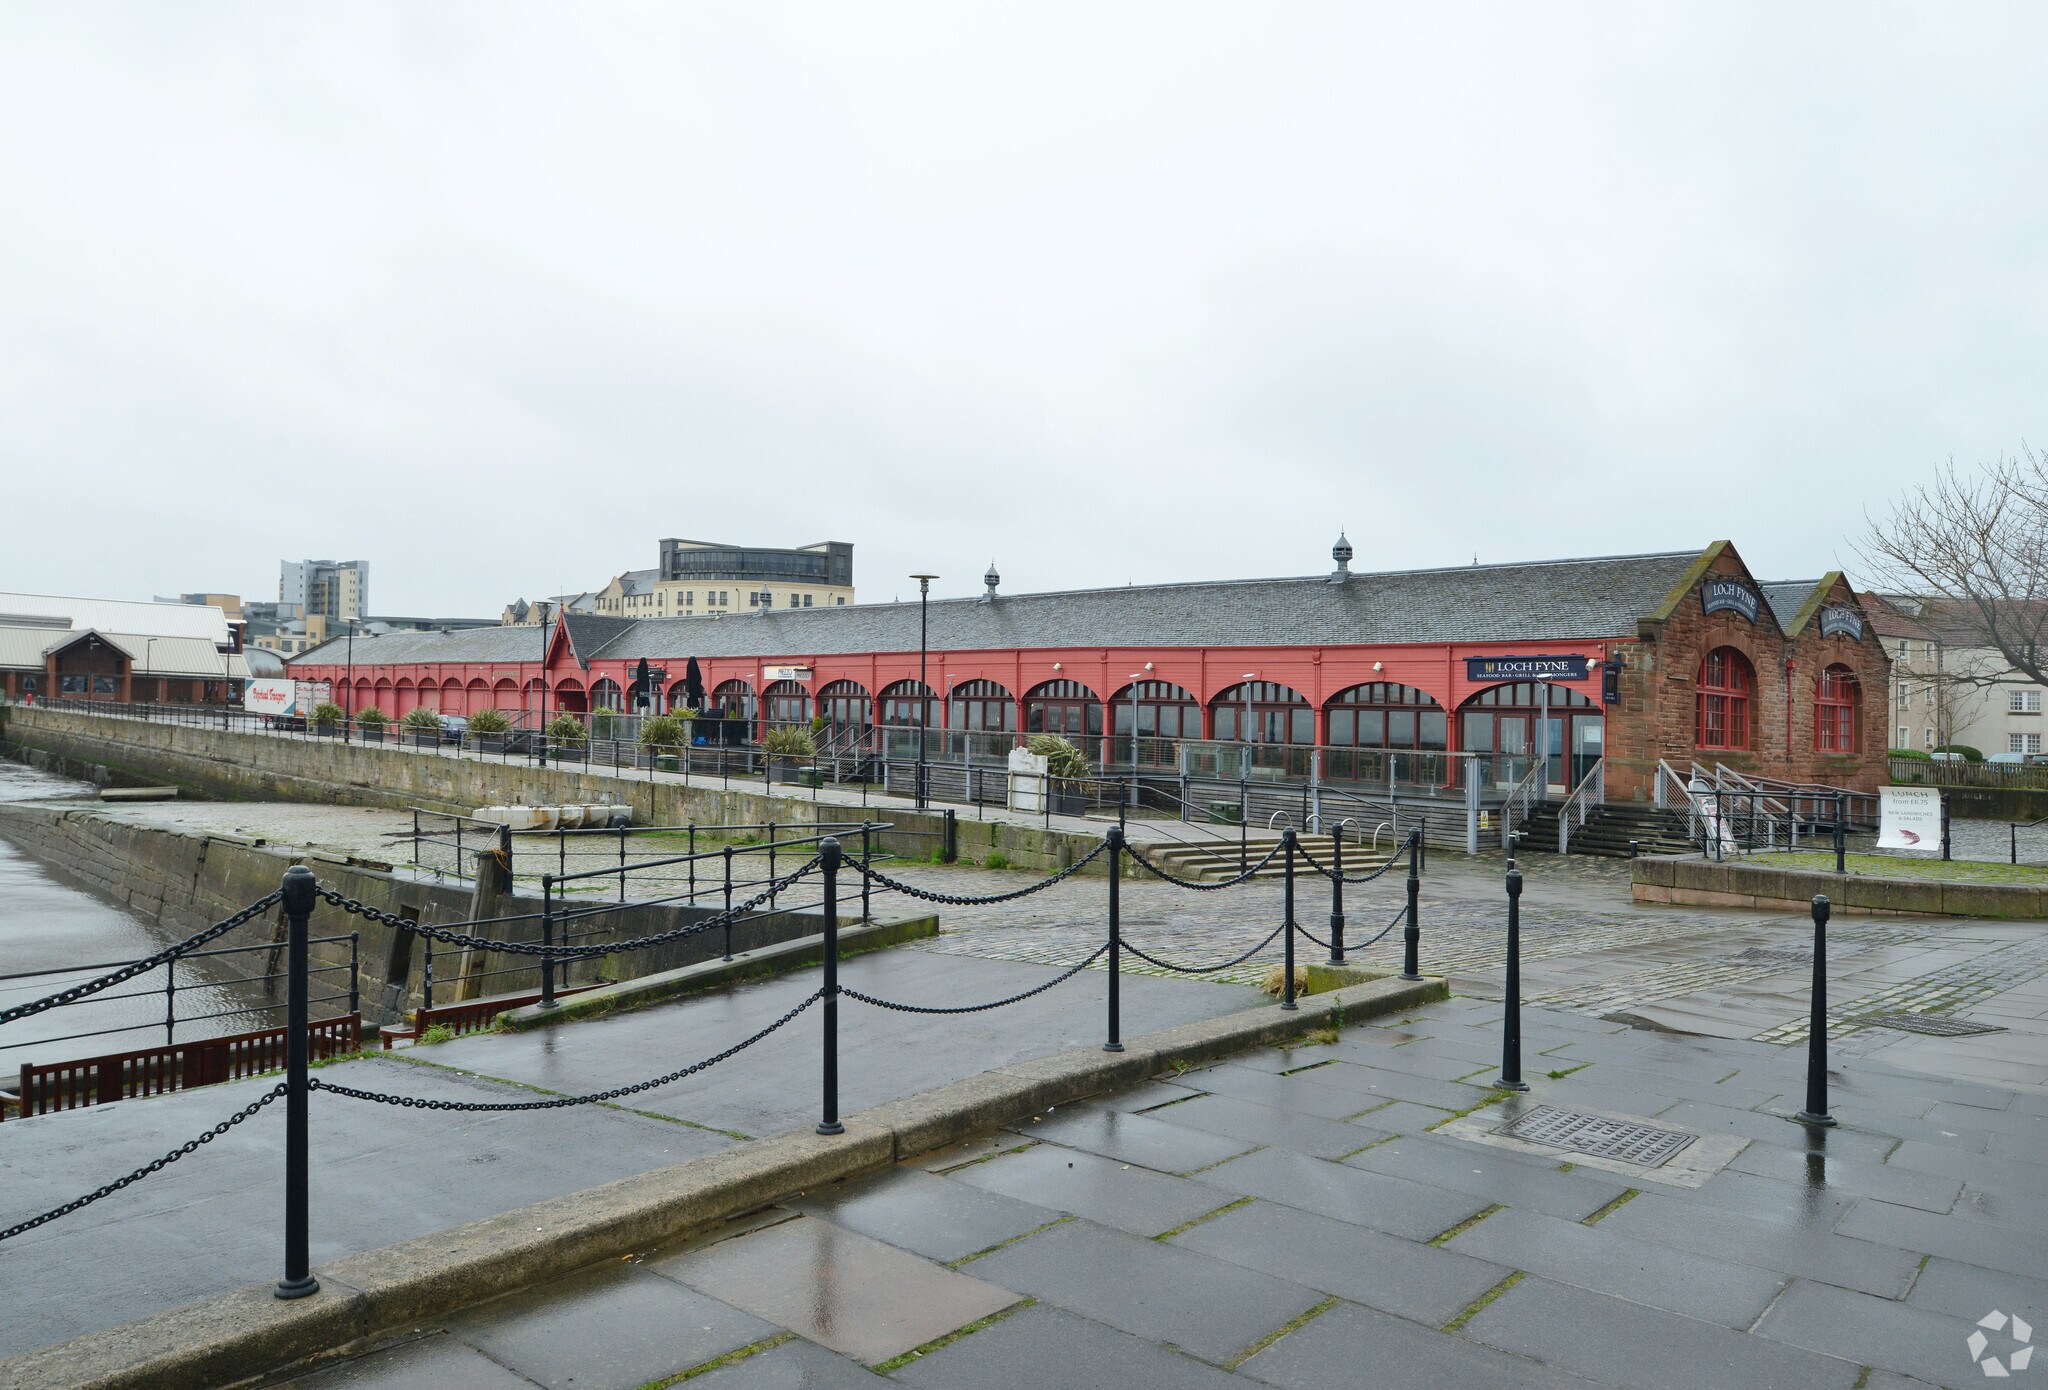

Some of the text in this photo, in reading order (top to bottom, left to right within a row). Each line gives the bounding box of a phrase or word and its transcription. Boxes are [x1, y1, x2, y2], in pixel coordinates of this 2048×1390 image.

[1713, 583, 1756, 609] LOCH FYNE
[1497, 661, 1569, 672] LOCH FYNE
